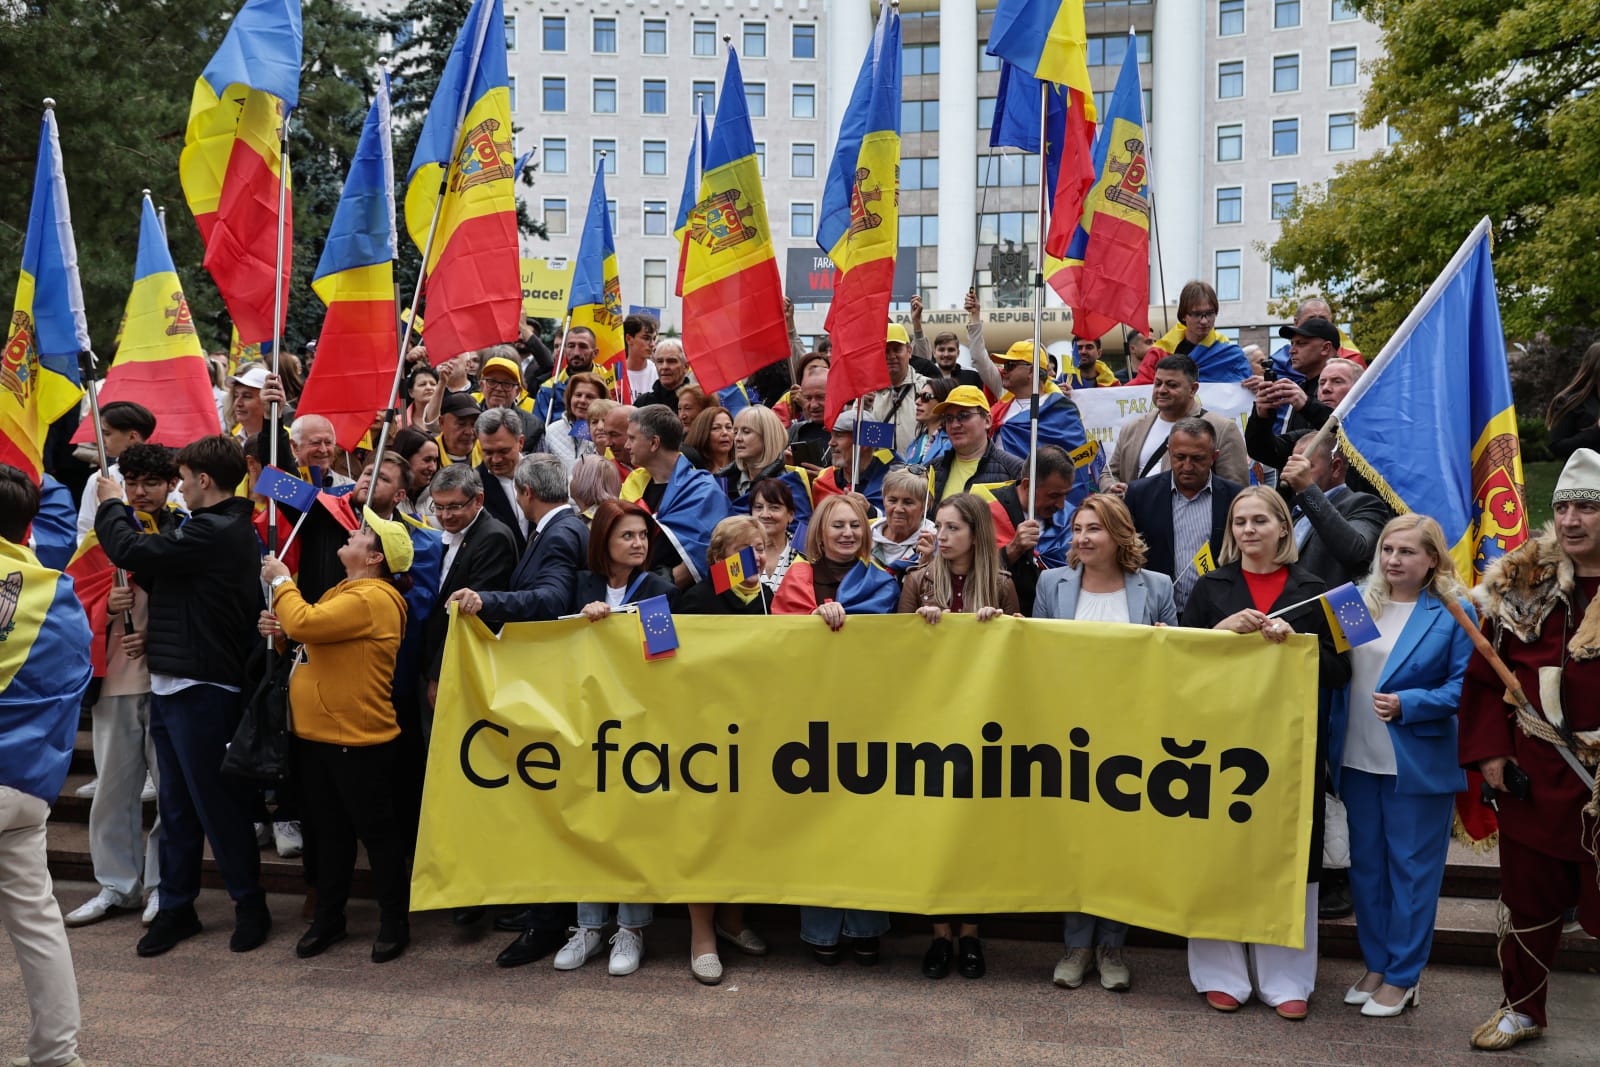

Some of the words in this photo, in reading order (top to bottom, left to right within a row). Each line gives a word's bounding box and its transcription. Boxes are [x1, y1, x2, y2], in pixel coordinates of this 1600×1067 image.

[521, 271, 533, 284] ul
[989, 311, 1056, 322] REPUBLCII
[459, 718, 561, 791] Ce
[591, 719, 739, 794] faci
[771, 721, 1270, 824] duminică?
